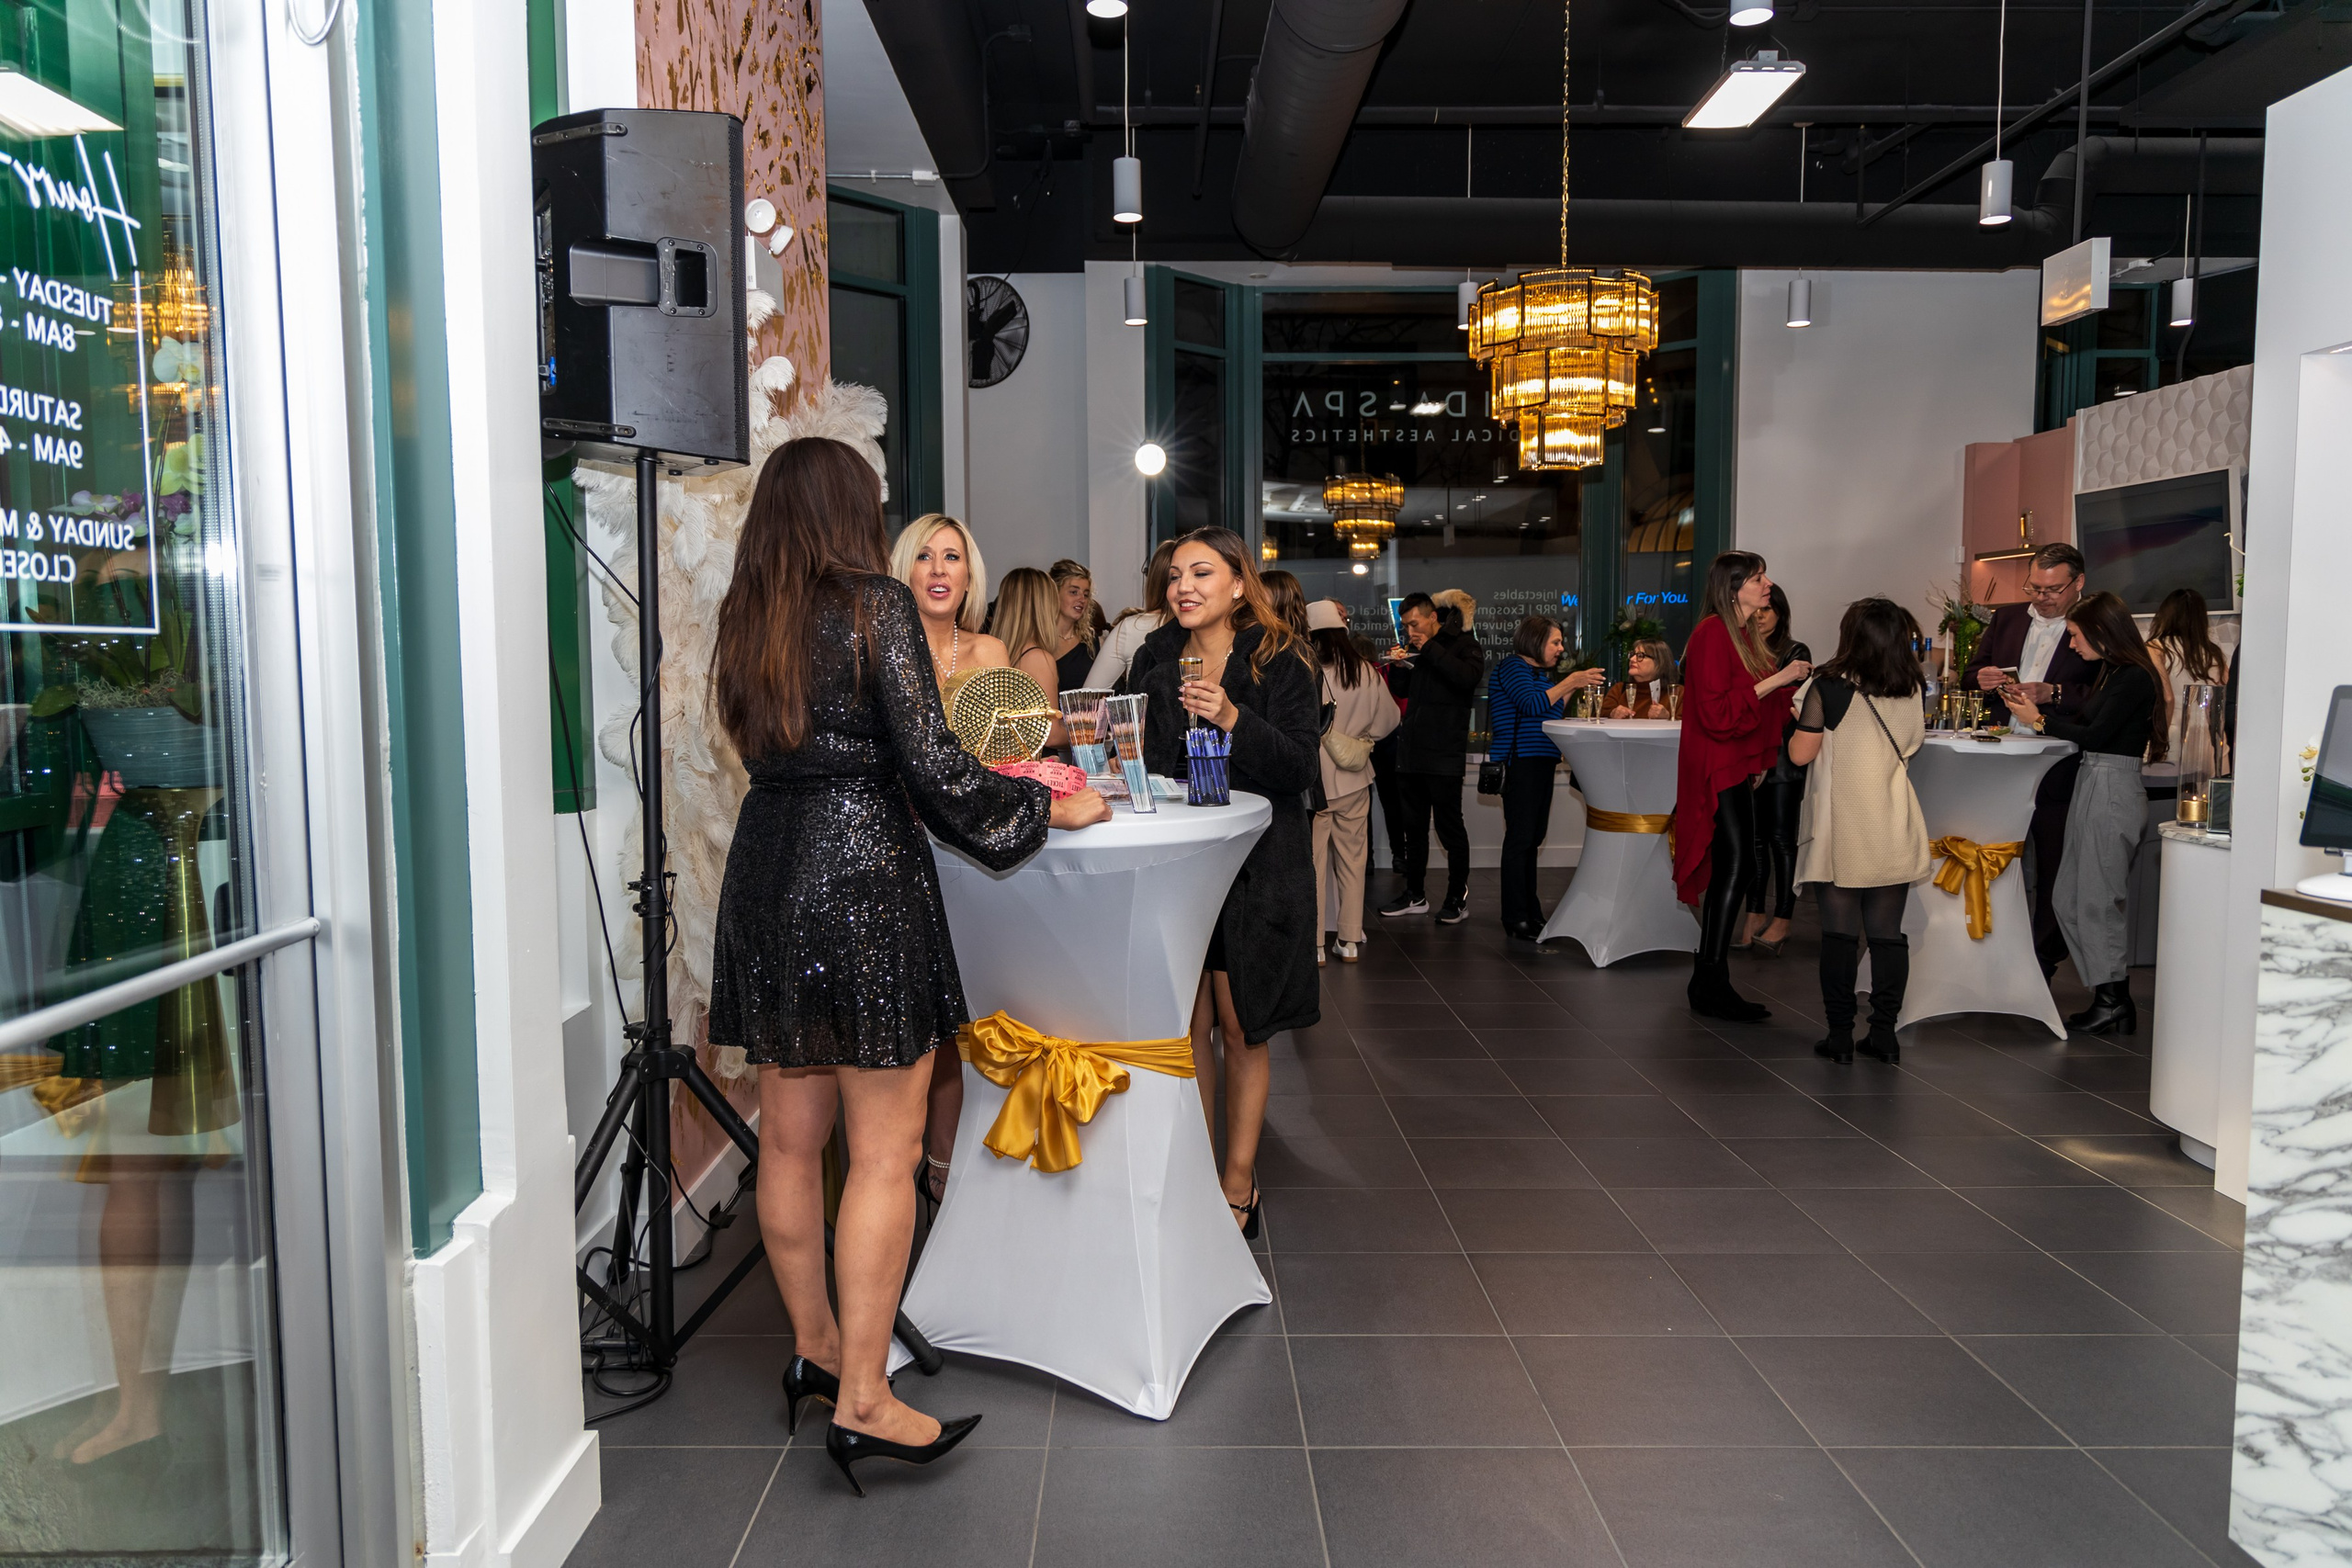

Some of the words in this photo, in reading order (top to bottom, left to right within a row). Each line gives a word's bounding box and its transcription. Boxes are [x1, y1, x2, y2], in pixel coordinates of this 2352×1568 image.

[1634, 591, 1659, 605] For
[1660, 591, 1689, 604] You.
[1046, 780, 1064, 788] TICKET
